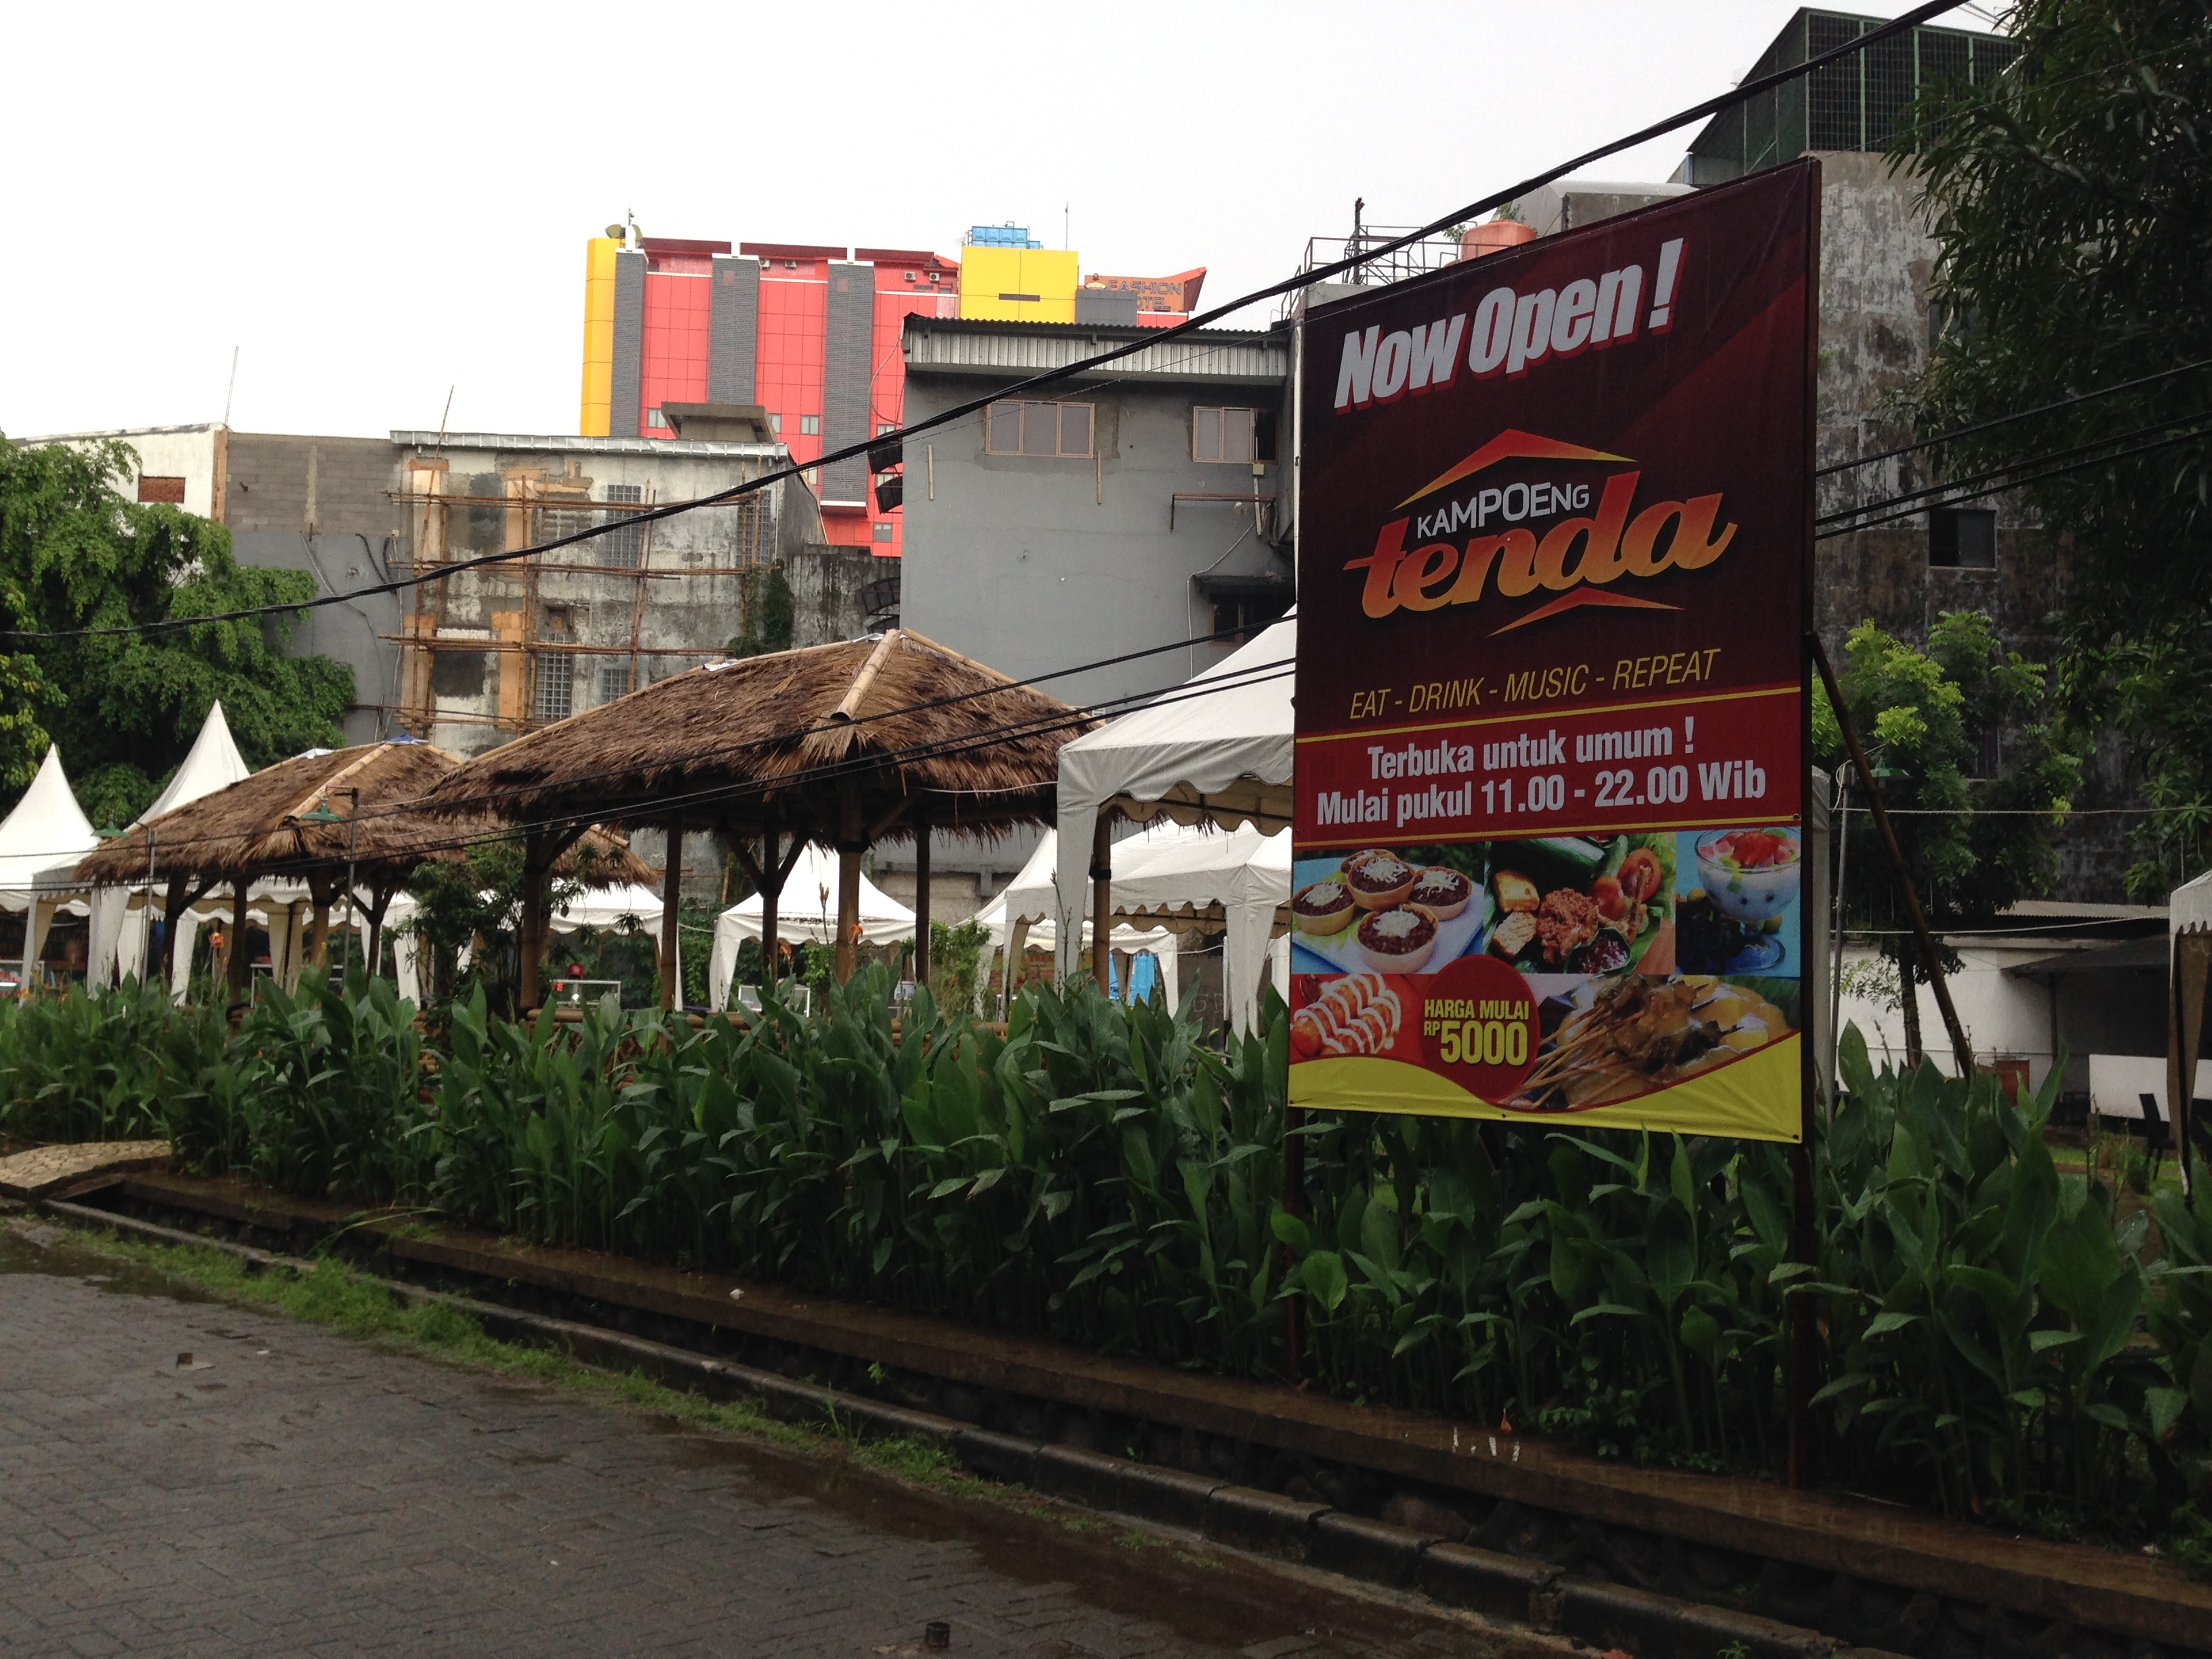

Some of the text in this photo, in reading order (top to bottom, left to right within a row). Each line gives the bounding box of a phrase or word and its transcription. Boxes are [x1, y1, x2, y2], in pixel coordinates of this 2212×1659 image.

[1107, 280, 1181, 295] FASHION
[1136, 296, 1171, 310] TEL
[1468, 263, 1644, 375] Open
[1649, 237, 1685, 330] !
[1416, 481, 1590, 539] KAMPOENG
[1343, 470, 1738, 619] tenda
[1350, 688, 1392, 720] EAT
[1408, 677, 1484, 712] DRINK
[1504, 663, 1589, 703] MUSIC
[1612, 649, 1721, 690] REPEAT
[1368, 716, 1695, 780] Terbuka untuk umum !
[1317, 787, 1389, 825] Mulai
[1396, 781, 1472, 828] pukul
[1481, 773, 1566, 814] 11.00
[1595, 765, 1689, 808] 22.00
[1698, 760, 1766, 800] Wib
[1424, 999, 1530, 1020] HARGA MULAI
[1424, 1020, 1528, 1066] RP 5000
